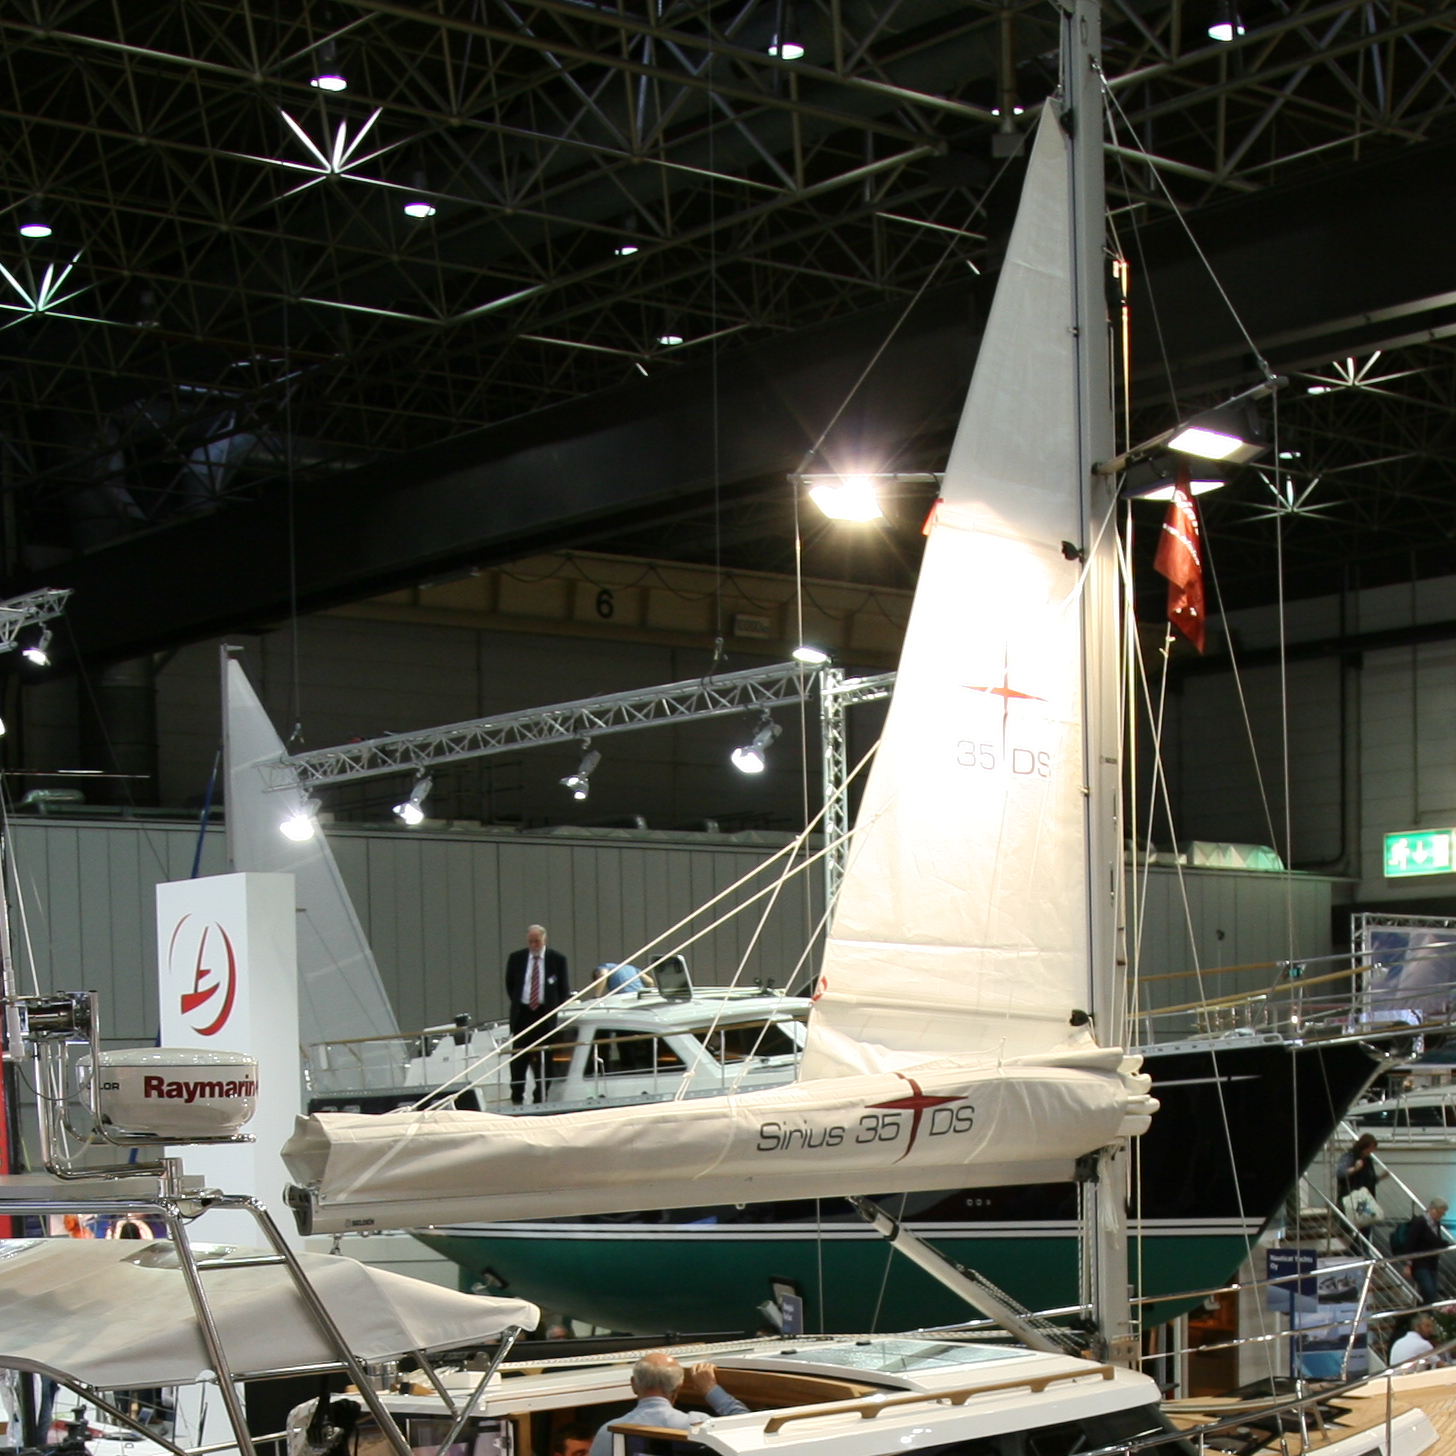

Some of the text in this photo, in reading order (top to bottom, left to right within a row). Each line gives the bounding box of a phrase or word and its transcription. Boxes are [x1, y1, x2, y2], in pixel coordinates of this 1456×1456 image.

[597, 588, 614, 618] 6
[957, 740, 1051, 778] 35 DS
[756, 1105, 975, 1151] Sirius 35 DS
